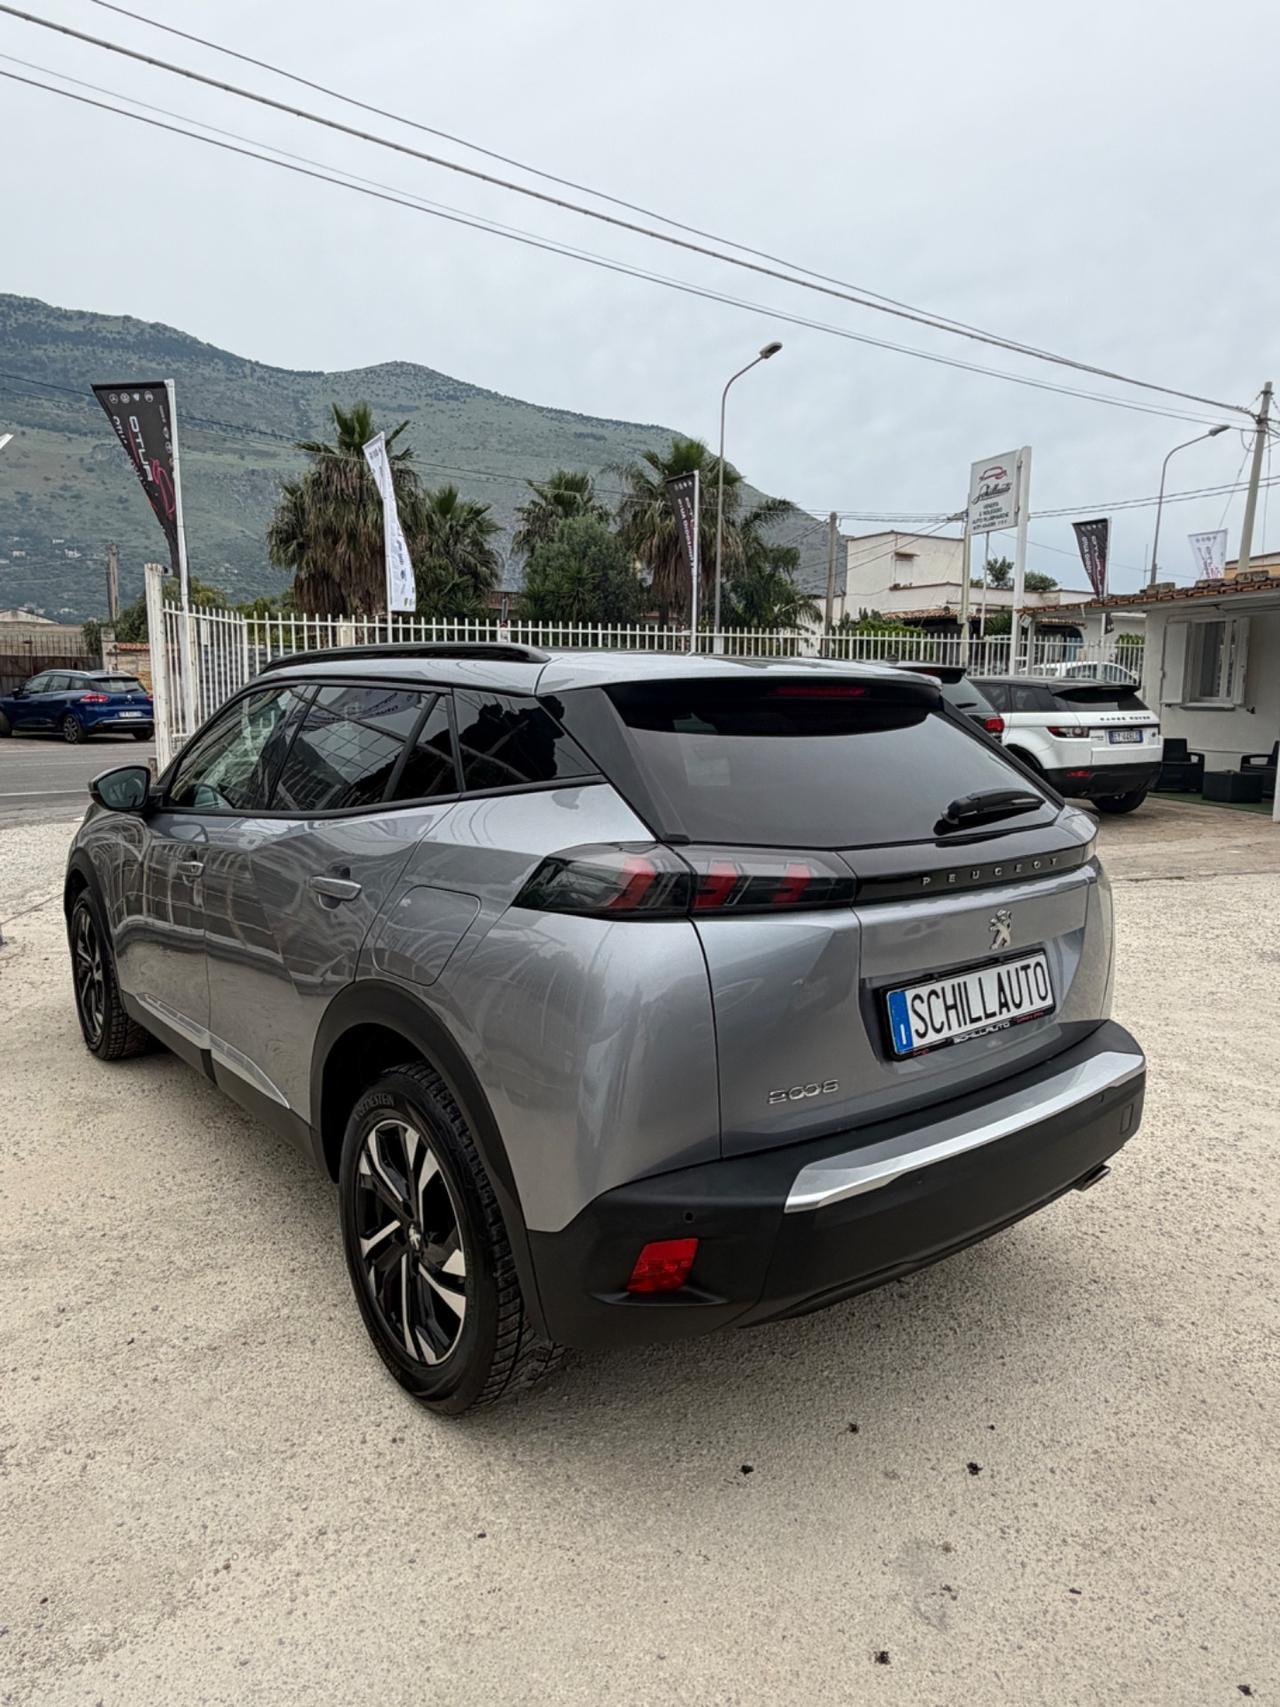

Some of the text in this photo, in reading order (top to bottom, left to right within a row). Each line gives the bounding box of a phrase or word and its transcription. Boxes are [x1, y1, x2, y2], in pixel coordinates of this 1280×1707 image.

[922, 857, 1057, 887] PEUGEOT
[911, 961, 1049, 1039] SCHILLAUTO
[768, 1079, 839, 1104] 2008
